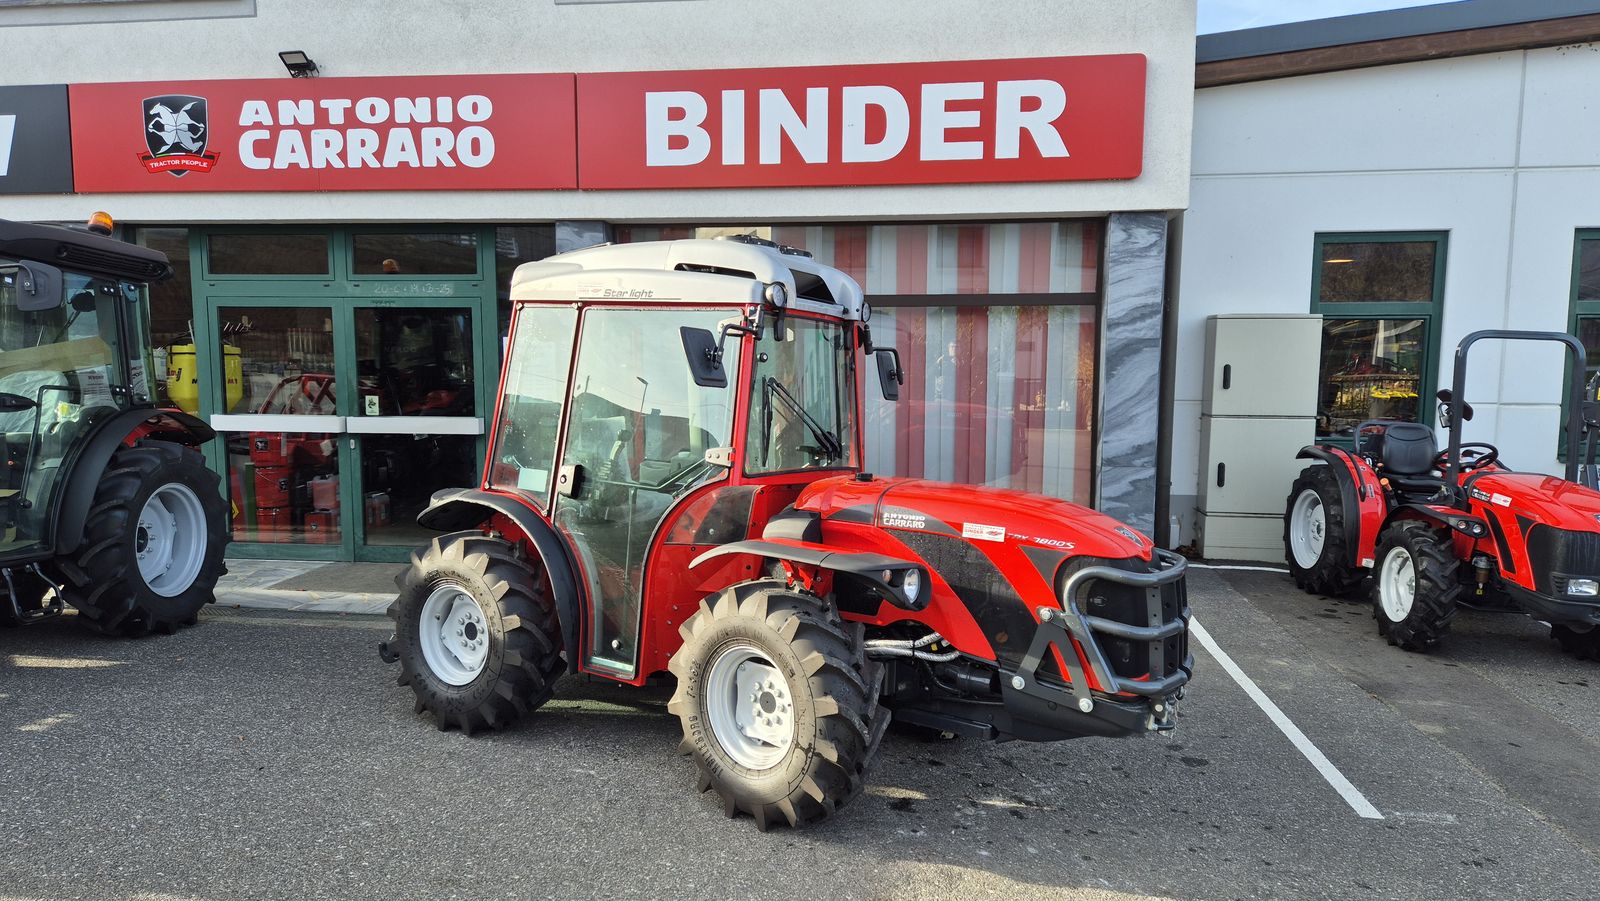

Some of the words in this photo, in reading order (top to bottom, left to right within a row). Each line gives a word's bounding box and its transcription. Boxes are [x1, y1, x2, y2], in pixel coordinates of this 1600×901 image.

[238, 95, 493, 126] ANTONIO
[645, 79, 1070, 167] BINDER
[238, 126, 495, 170] CARRARO
[150, 159, 180, 168] TRACTOR
[181, 159, 208, 168] PEOPLE
[883, 512, 925, 521] ANTONIO
[883, 518, 925, 529] CARRARO
[1034, 537, 1076, 549] 7800S
